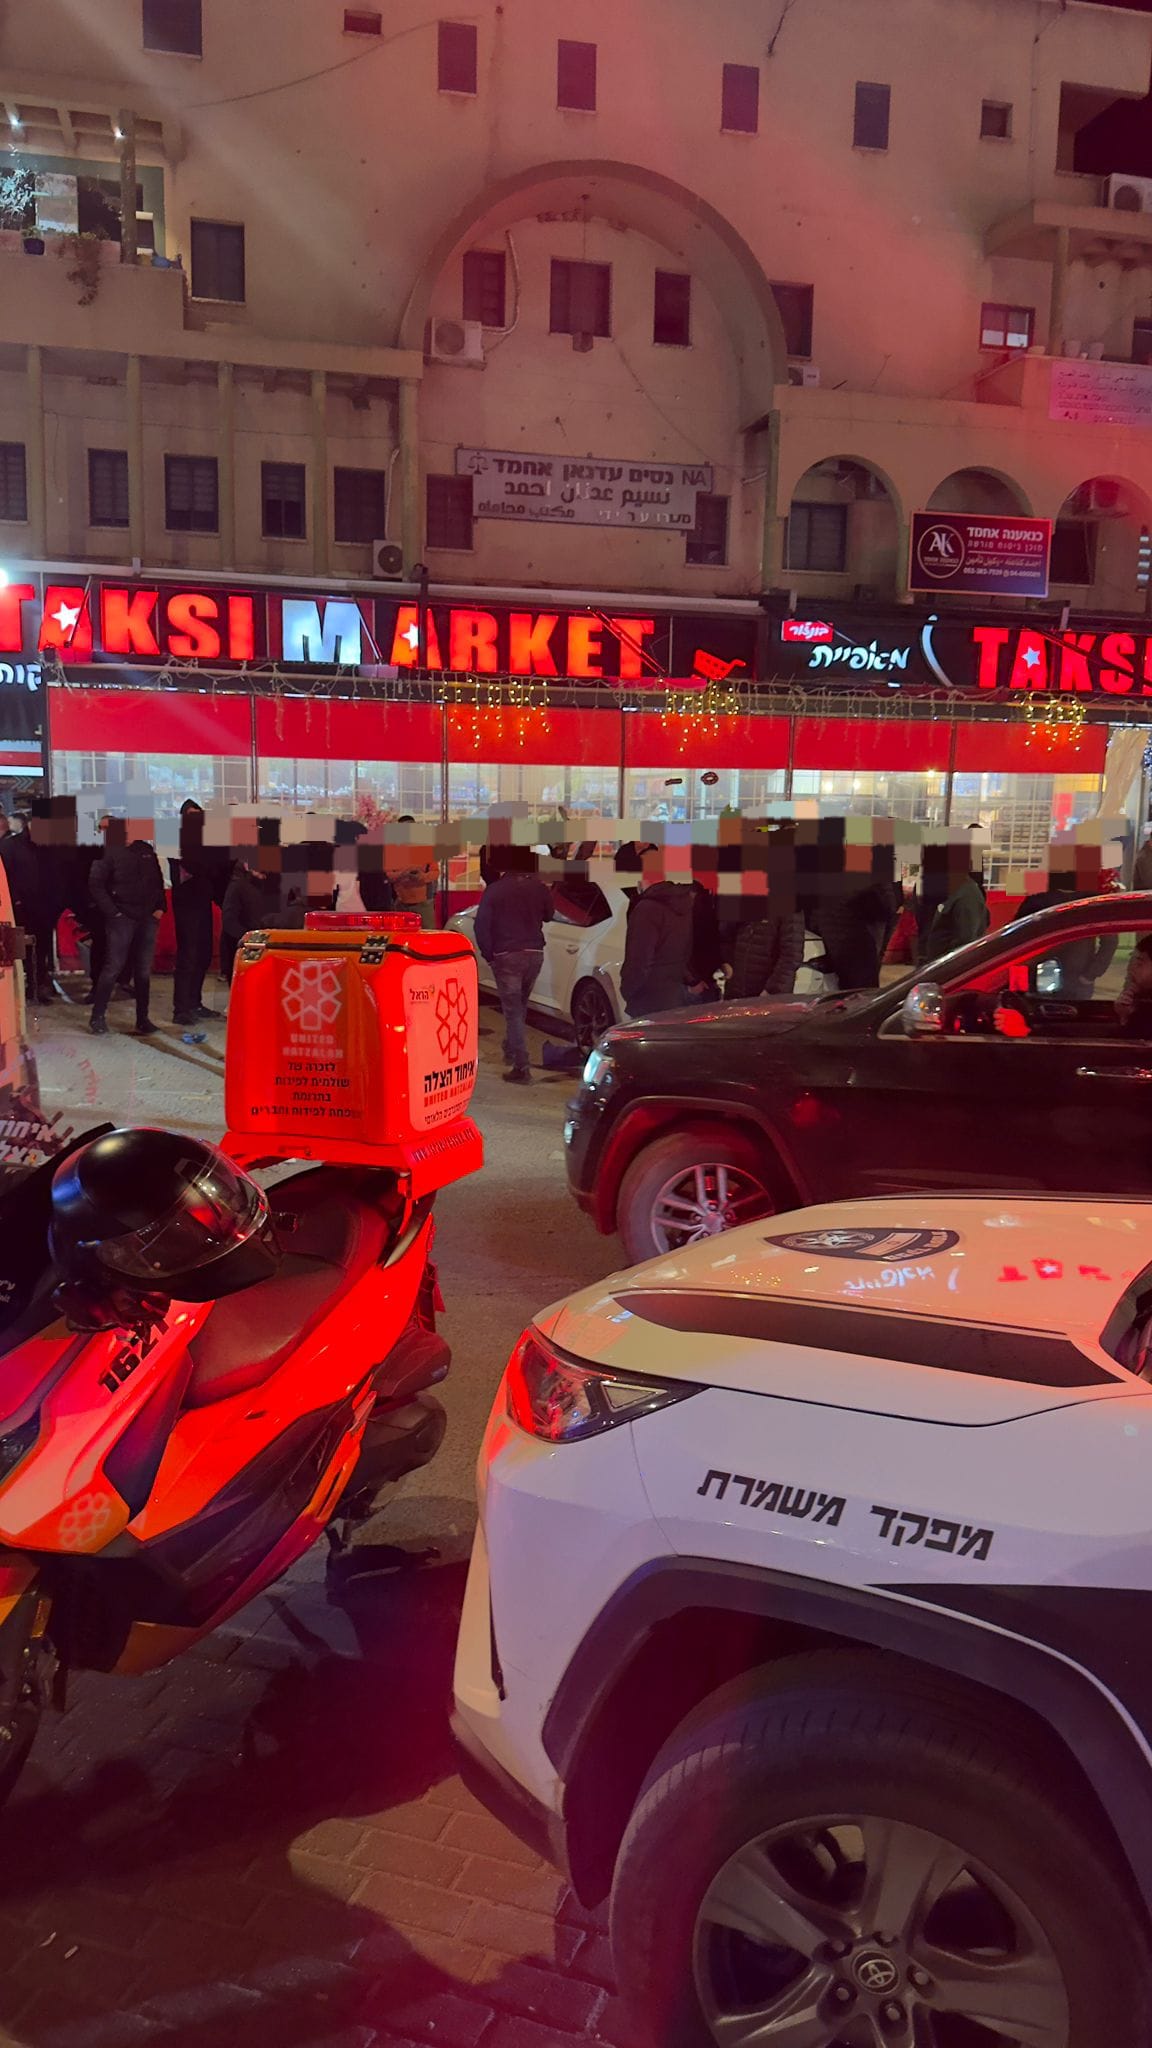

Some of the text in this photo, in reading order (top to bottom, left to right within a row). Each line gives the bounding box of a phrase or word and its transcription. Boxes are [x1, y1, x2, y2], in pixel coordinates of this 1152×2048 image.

[492, 457, 675, 486] נסים עדנאן אחמד
[681, 469, 708, 487] NA
[967, 526, 1044, 542] כנאענה אחמד
[282, 598, 655, 679] MARKET
[808, 640, 912, 671] מאפיית
[290, 1033, 334, 1044] UNITED
[282, 1046, 344, 1059] HATZALAH
[424, 1067, 453, 1094] הצלה
[696, 1468, 995, 1562] מפקד משמרת
